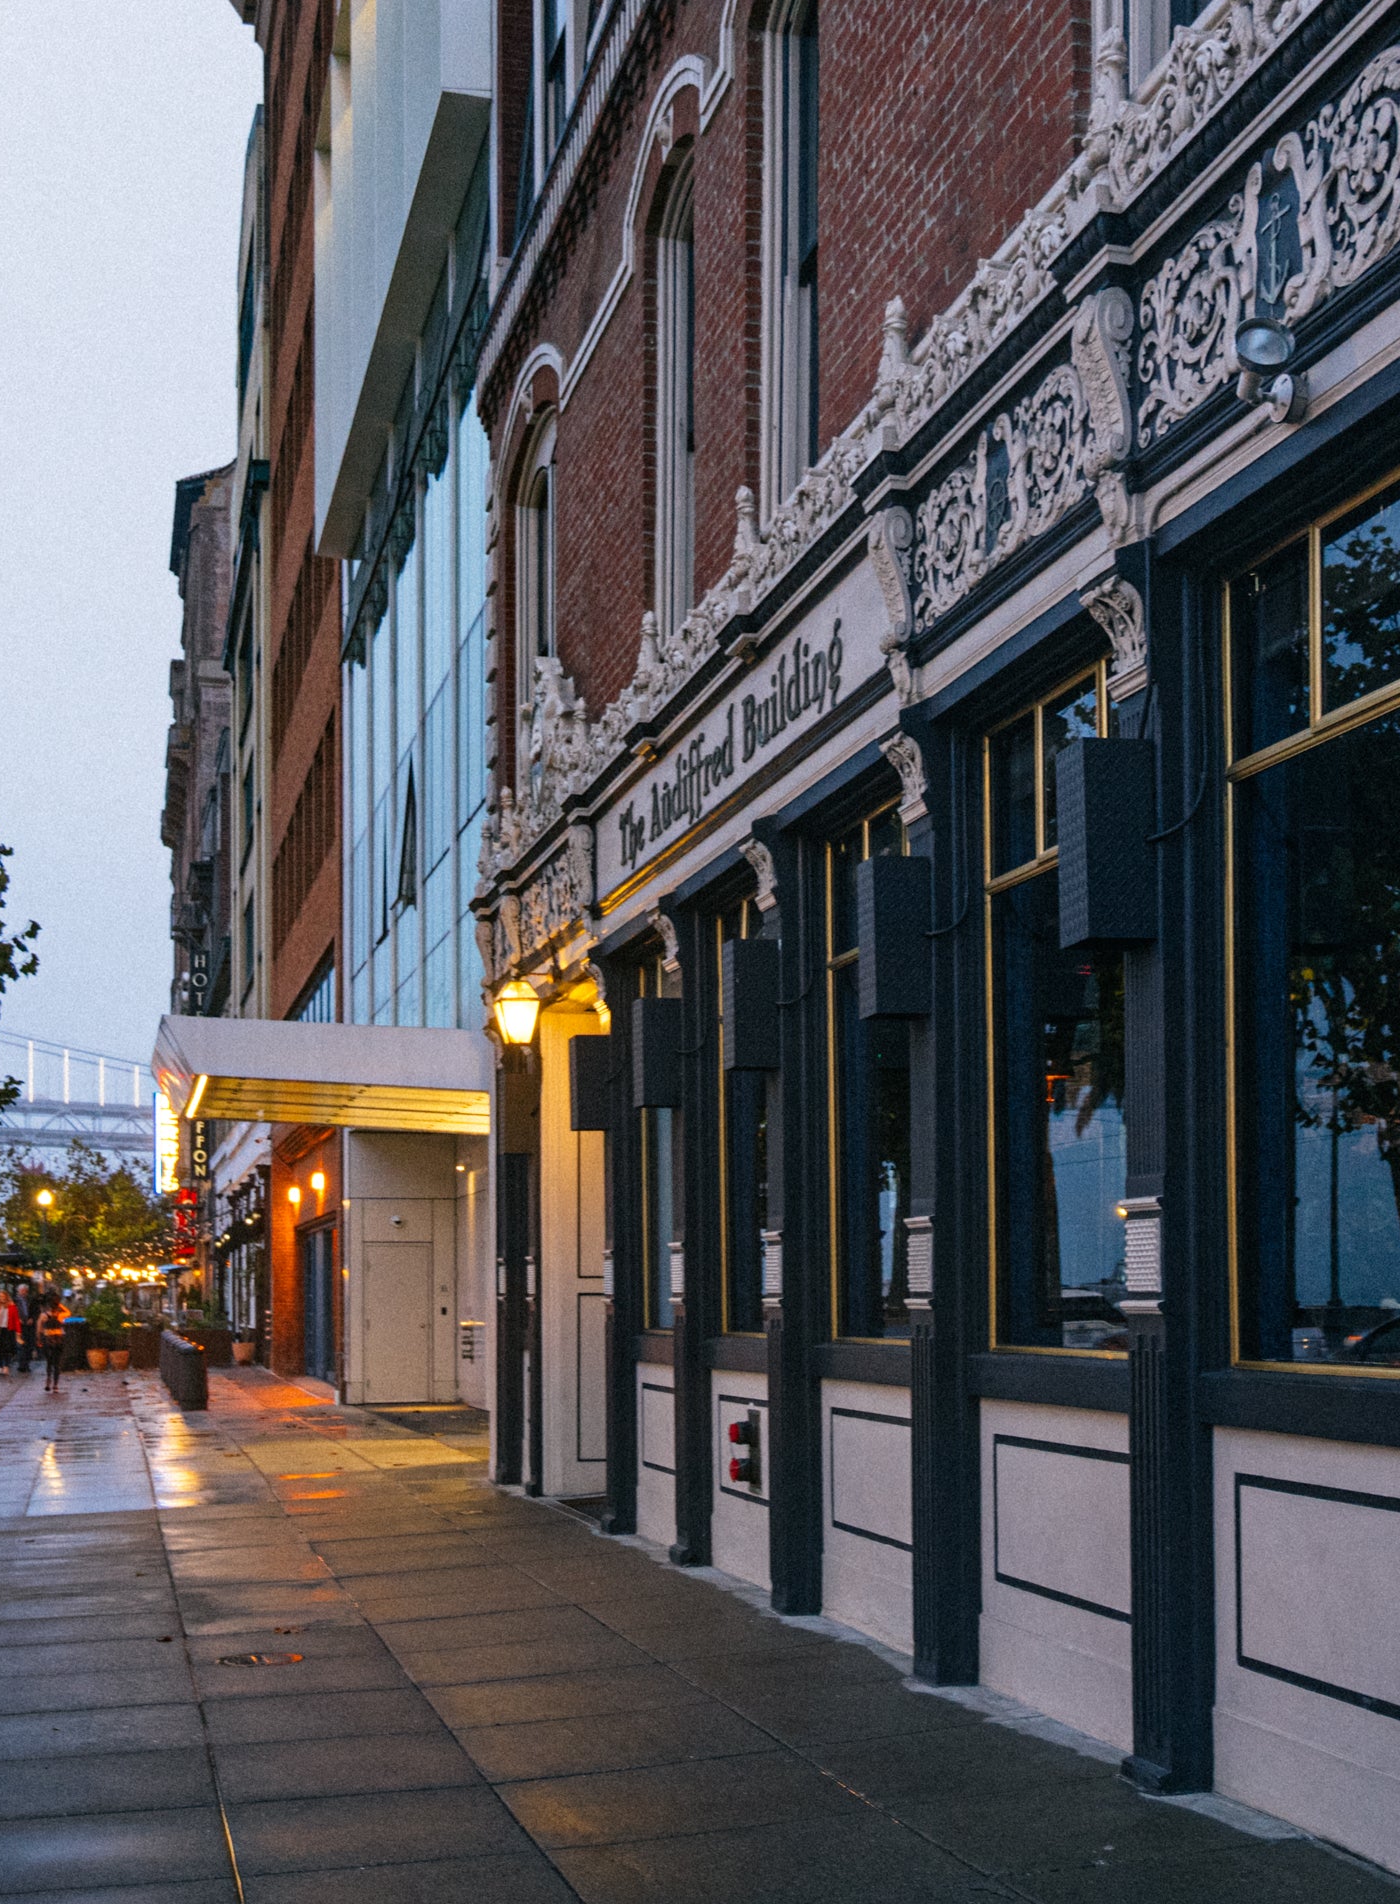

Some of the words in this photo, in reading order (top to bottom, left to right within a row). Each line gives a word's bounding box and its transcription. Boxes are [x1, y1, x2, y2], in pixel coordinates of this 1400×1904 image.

[619, 800, 646, 870] The
[649, 702, 735, 843] Audiffred
[742, 617, 843, 764] Building
